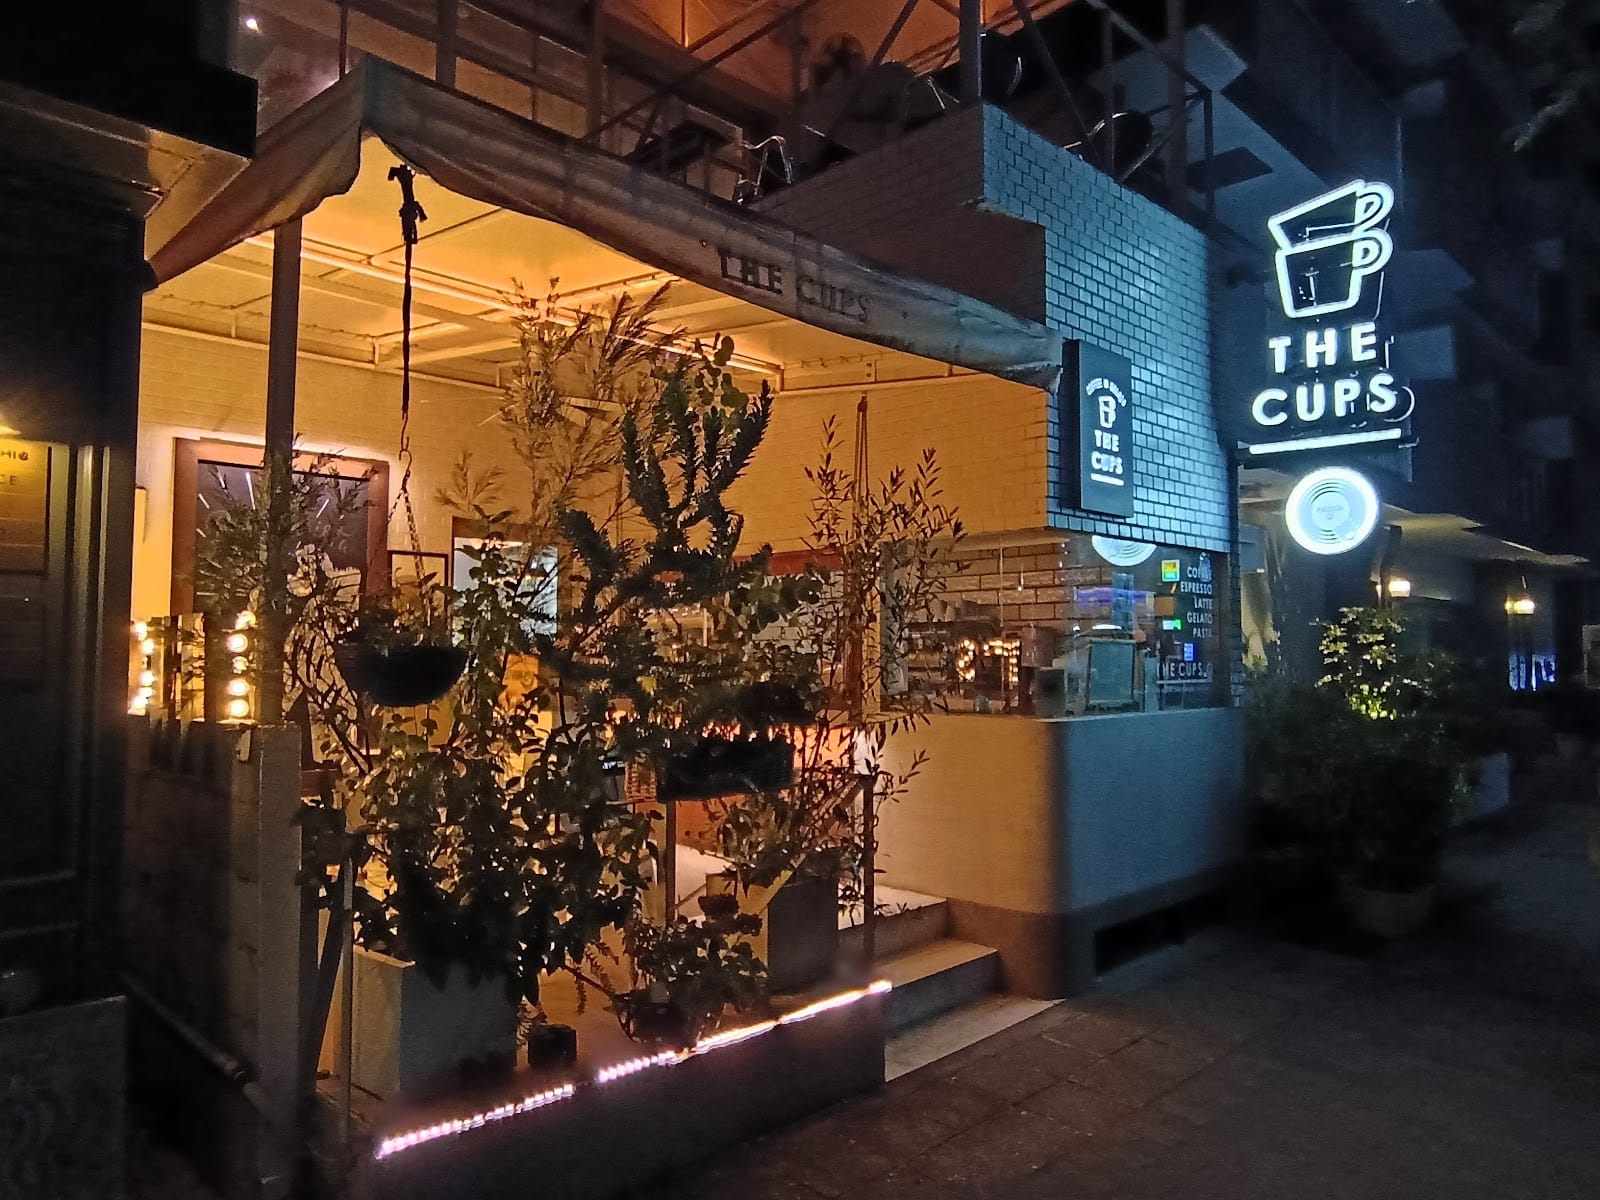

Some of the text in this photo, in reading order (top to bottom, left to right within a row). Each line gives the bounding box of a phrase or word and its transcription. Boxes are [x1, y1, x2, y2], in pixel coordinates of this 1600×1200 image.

[1268, 321, 1377, 374] THE
[1252, 373, 1397, 426] CUPS
[1094, 429, 1119, 452] THE
[1180, 581, 1213, 595] ESPRESSO
[1186, 612, 1213, 624] GELATO
